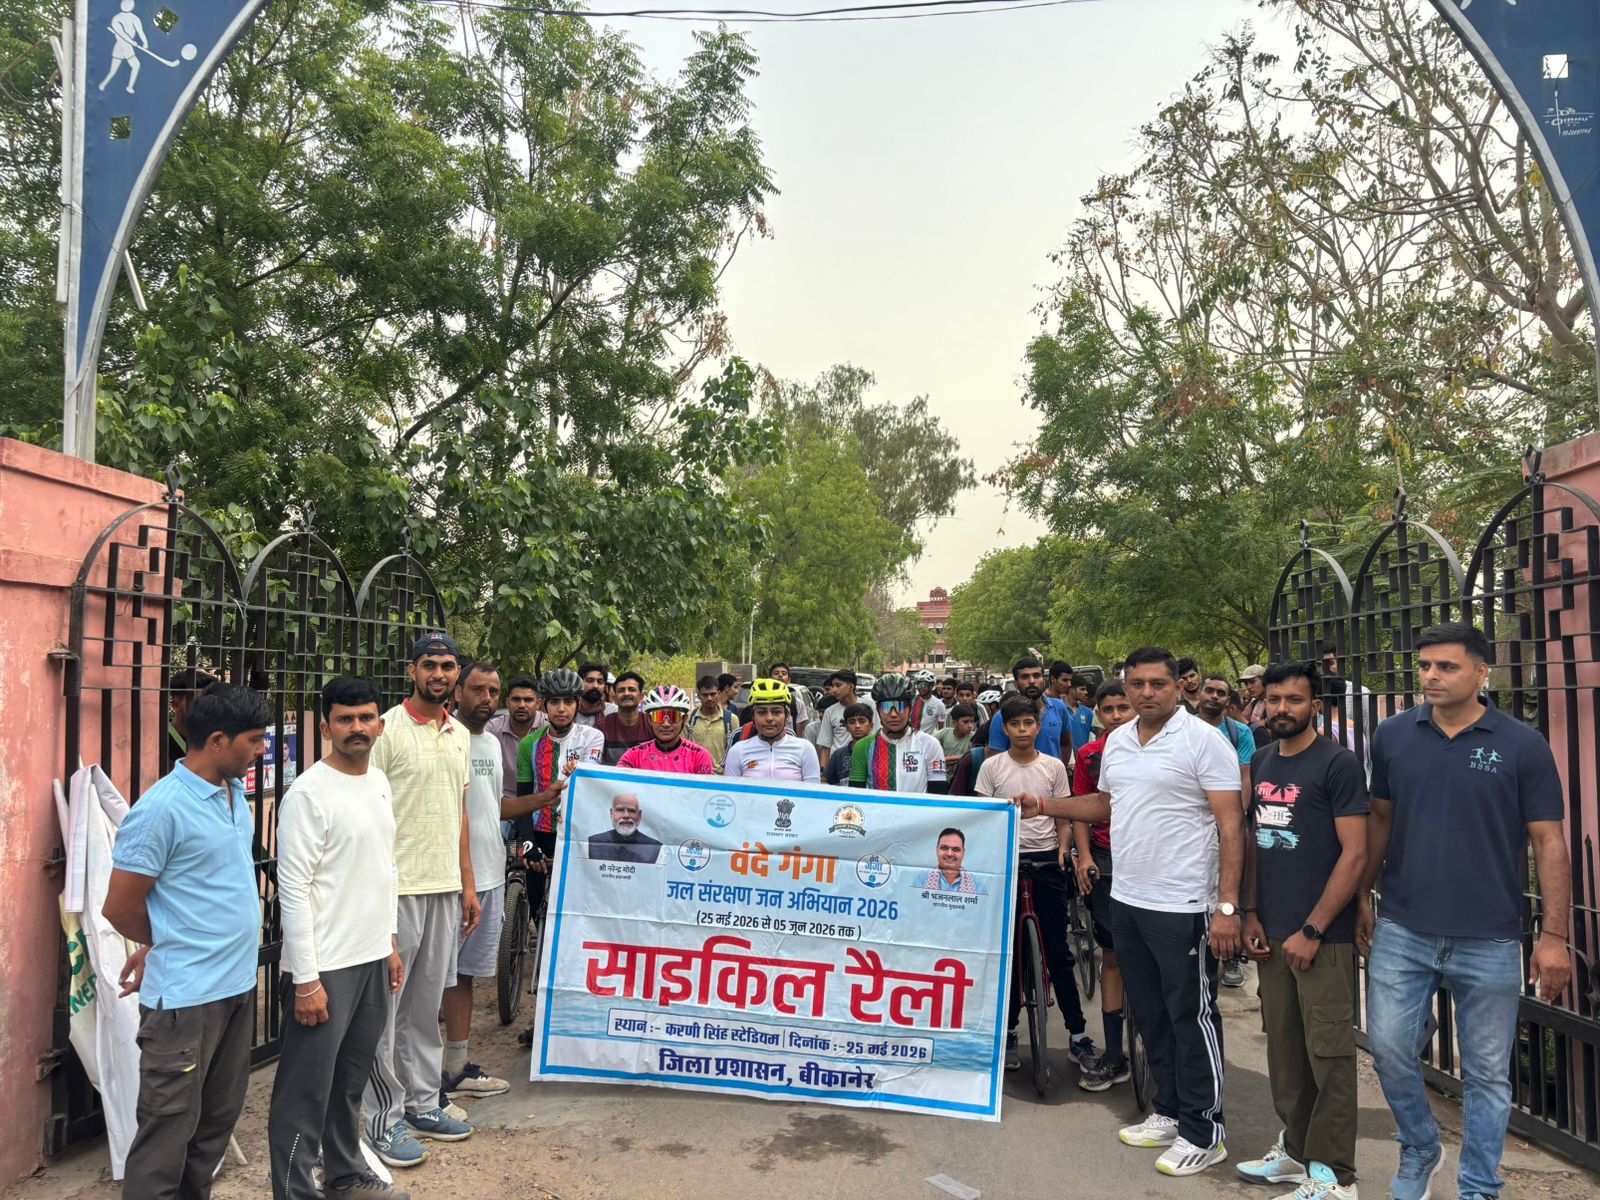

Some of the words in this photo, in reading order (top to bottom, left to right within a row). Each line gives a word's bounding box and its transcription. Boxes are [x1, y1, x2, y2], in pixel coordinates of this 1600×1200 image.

[471, 758, 495, 768] EQUI
[474, 767, 494, 777] NOX
[1470, 761, 1497, 773] BSSA
[728, 841, 773, 878] वंदे
[778, 845, 840, 884] गंगा
[666, 880, 696, 900] जल
[697, 879, 753, 905] संरक्षण
[755, 888, 785, 909] जन
[787, 887, 854, 916] अभियान
[856, 897, 899, 921] 2026
[696, 910, 714, 926] (25
[716, 911, 732, 927] मई
[732, 915, 759, 929] 2026
[761, 915, 771, 930] से
[773, 919, 787, 931] 05
[788, 920, 808, 936] जून
[808, 922, 836, 937] 2026
[837, 925, 856, 938] तक
[582, 934, 835, 1018] साइकिल
[844, 947, 974, 1029] रैली
[614, 1017, 648, 1034] स्थान
[665, 1021, 701, 1039] करणी
[703, 1024, 729, 1041] सिंह
[731, 1026, 780, 1046] स्टेडियम
[788, 1031, 831, 1051] दिनांक
[866, 1041, 888, 1057] मई
[891, 1044, 928, 1059] 2026
[658, 1047, 713, 1075] जिला
[798, 1061, 876, 1089] बीकानेर
